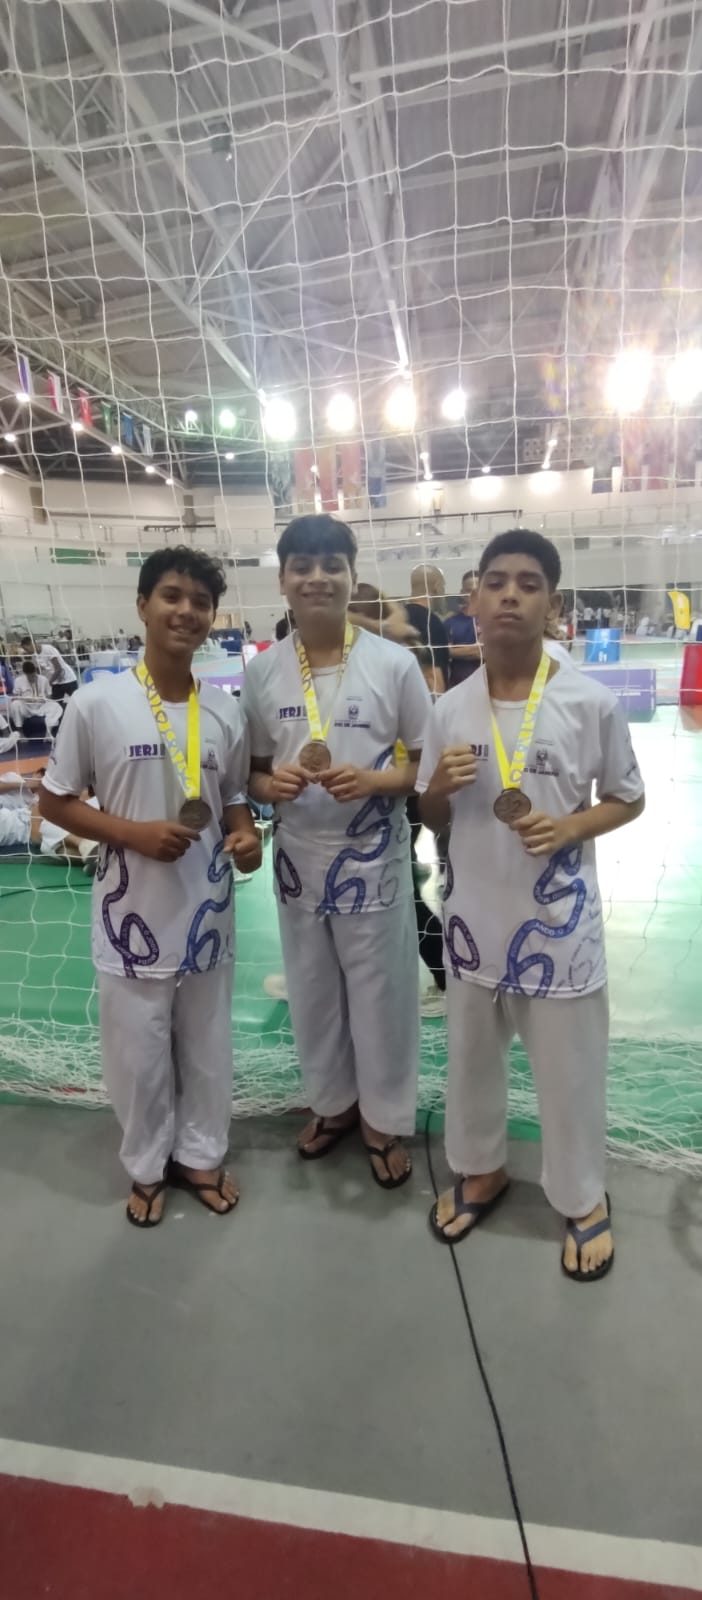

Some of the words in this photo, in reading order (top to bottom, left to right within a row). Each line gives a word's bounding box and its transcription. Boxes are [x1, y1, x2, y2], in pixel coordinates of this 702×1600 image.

[279, 705, 301, 719] JERJ
[128, 743, 158, 757] JERJ
[470, 744, 482, 757] RJ
